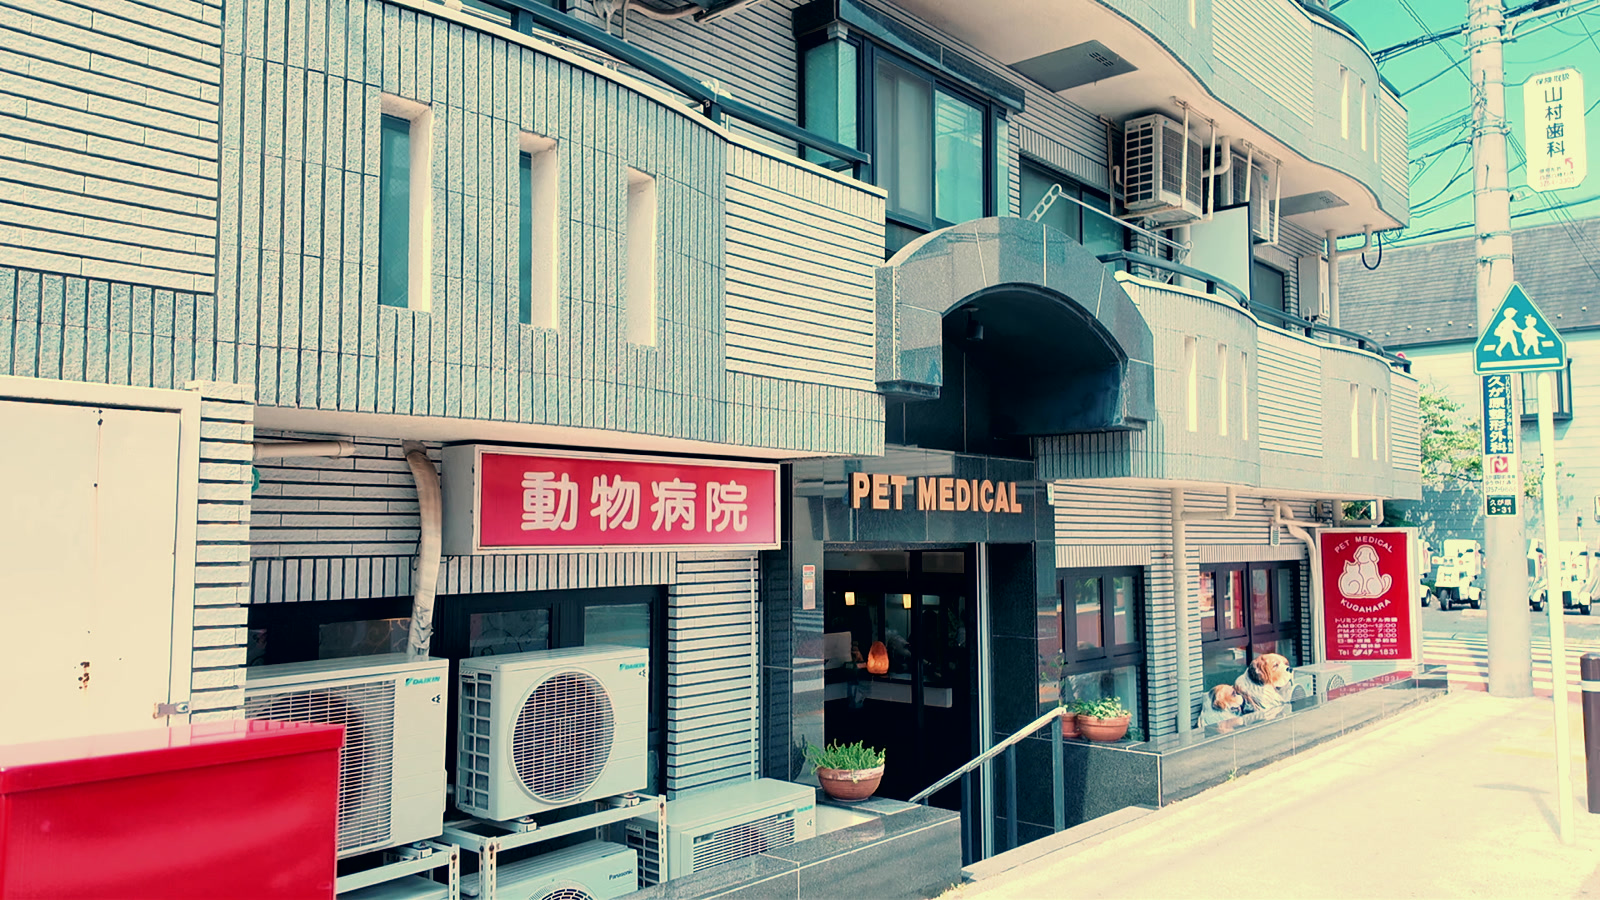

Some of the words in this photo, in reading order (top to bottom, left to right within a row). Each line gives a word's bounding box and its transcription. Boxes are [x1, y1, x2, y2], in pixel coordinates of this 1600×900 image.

[1544, 86, 1565, 158] 山村歯科
[1487, 375, 1507, 453] 久が原整形外科
[851, 472, 907, 510] PET
[917, 476, 1023, 513] MEDICAL
[520, 471, 748, 533] 動物病院
[1489, 498, 1512, 507] 久が原
[1491, 506, 1511, 514] 3-31
[1334, 539, 1350, 553] PET
[1354, 535, 1393, 553] MEDICAL
[1340, 598, 1391, 613] KUGAHARA
[1338, 648, 1350, 656] Tel
[412, 675, 441, 685] DAIKIN
